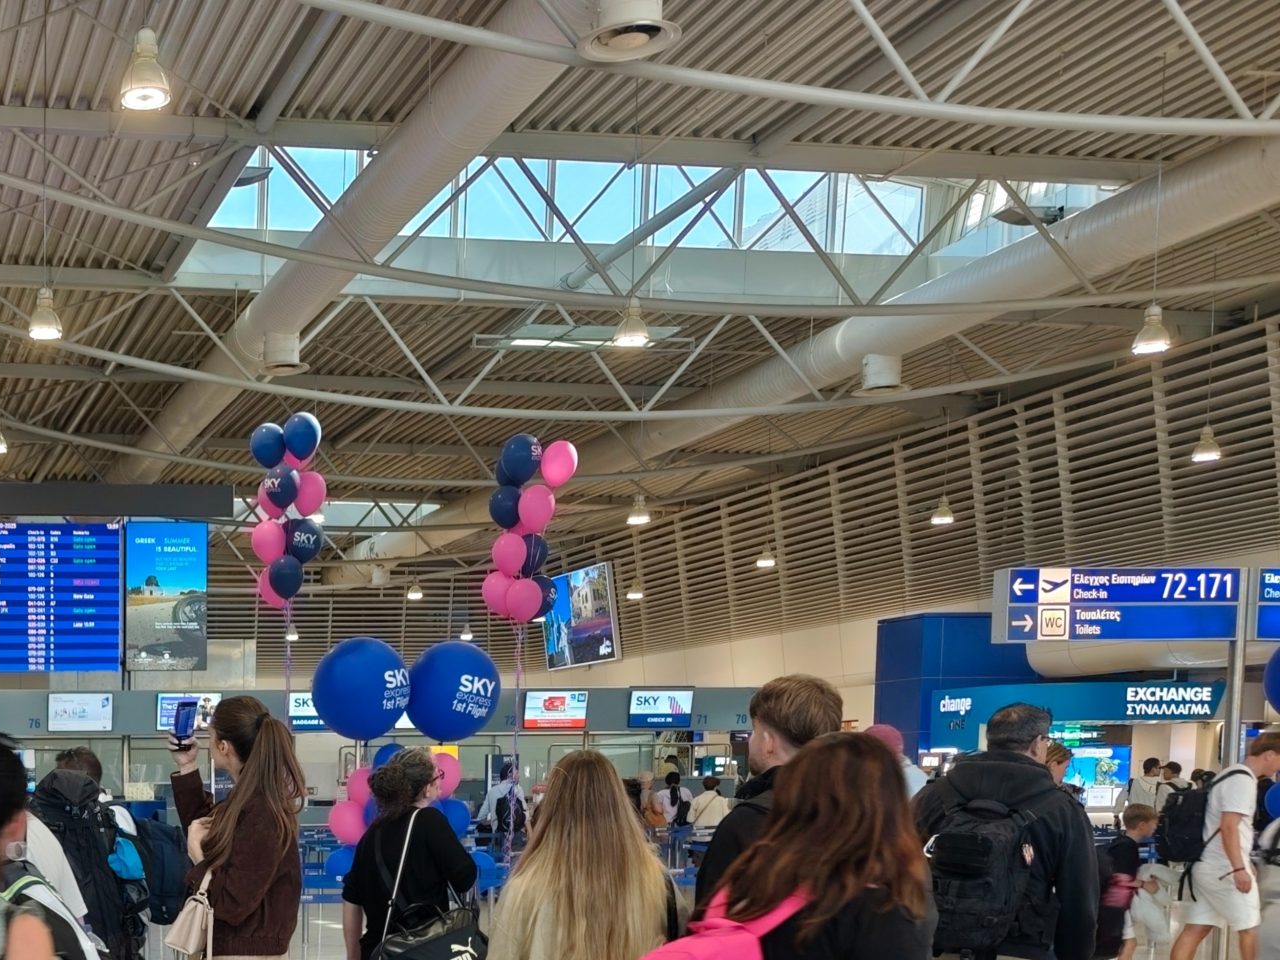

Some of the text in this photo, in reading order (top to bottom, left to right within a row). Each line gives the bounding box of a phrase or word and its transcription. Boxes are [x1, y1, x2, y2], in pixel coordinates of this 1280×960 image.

[531, 445, 542, 456] SK
[264, 478, 281, 489] SKY
[293, 531, 317, 544] SKY
[1071, 573, 1157, 586] Έλεγχος Εισιτηρίων
[1161, 573, 1233, 600] 72-171
[1073, 588, 1108, 599] Check-in
[1075, 609, 1121, 622] Τουαλέτες
[1044, 616, 1063, 629] WC
[1075, 624, 1102, 635] Toilets
[384, 668, 410, 689] SKY
[458, 674, 496, 698] SKY
[456, 691, 492, 707] express
[1126, 686, 1212, 702] EXCHANGE
[294, 697, 312, 708] SK
[382, 698, 394, 710] 1st
[636, 695, 660, 706] SKY
[939, 695, 972, 716] change
[452, 699, 489, 719] 1st Flight
[1126, 703, 1211, 715] ΣΥΝΑΛΛΑΓΜΑ
[29, 718, 41, 729] 76
[505, 716, 516, 726] 72
[696, 714, 708, 725] 71
[736, 713, 747, 724] 70
[949, 719, 965, 730] ONE
